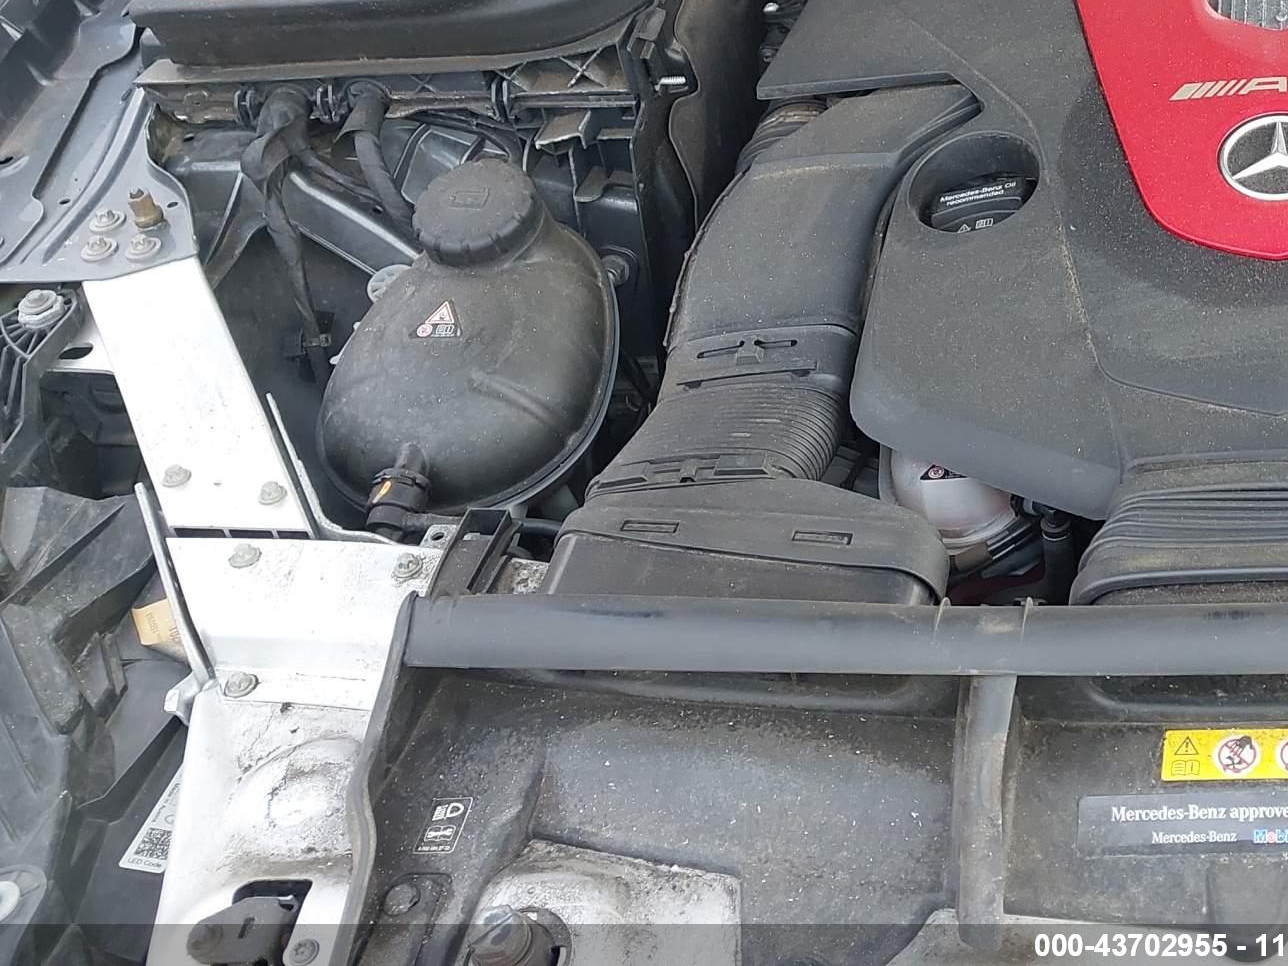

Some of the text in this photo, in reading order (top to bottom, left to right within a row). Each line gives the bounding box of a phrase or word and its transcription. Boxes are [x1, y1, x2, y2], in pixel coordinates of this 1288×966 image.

[940, 181, 1017, 202] Mercedes-Benz Oil
[1111, 804, 1227, 822] Mercedes-Benz
[1152, 830, 1238, 844] Mercedes-Benz
[127, 857, 162, 868] LED Code
